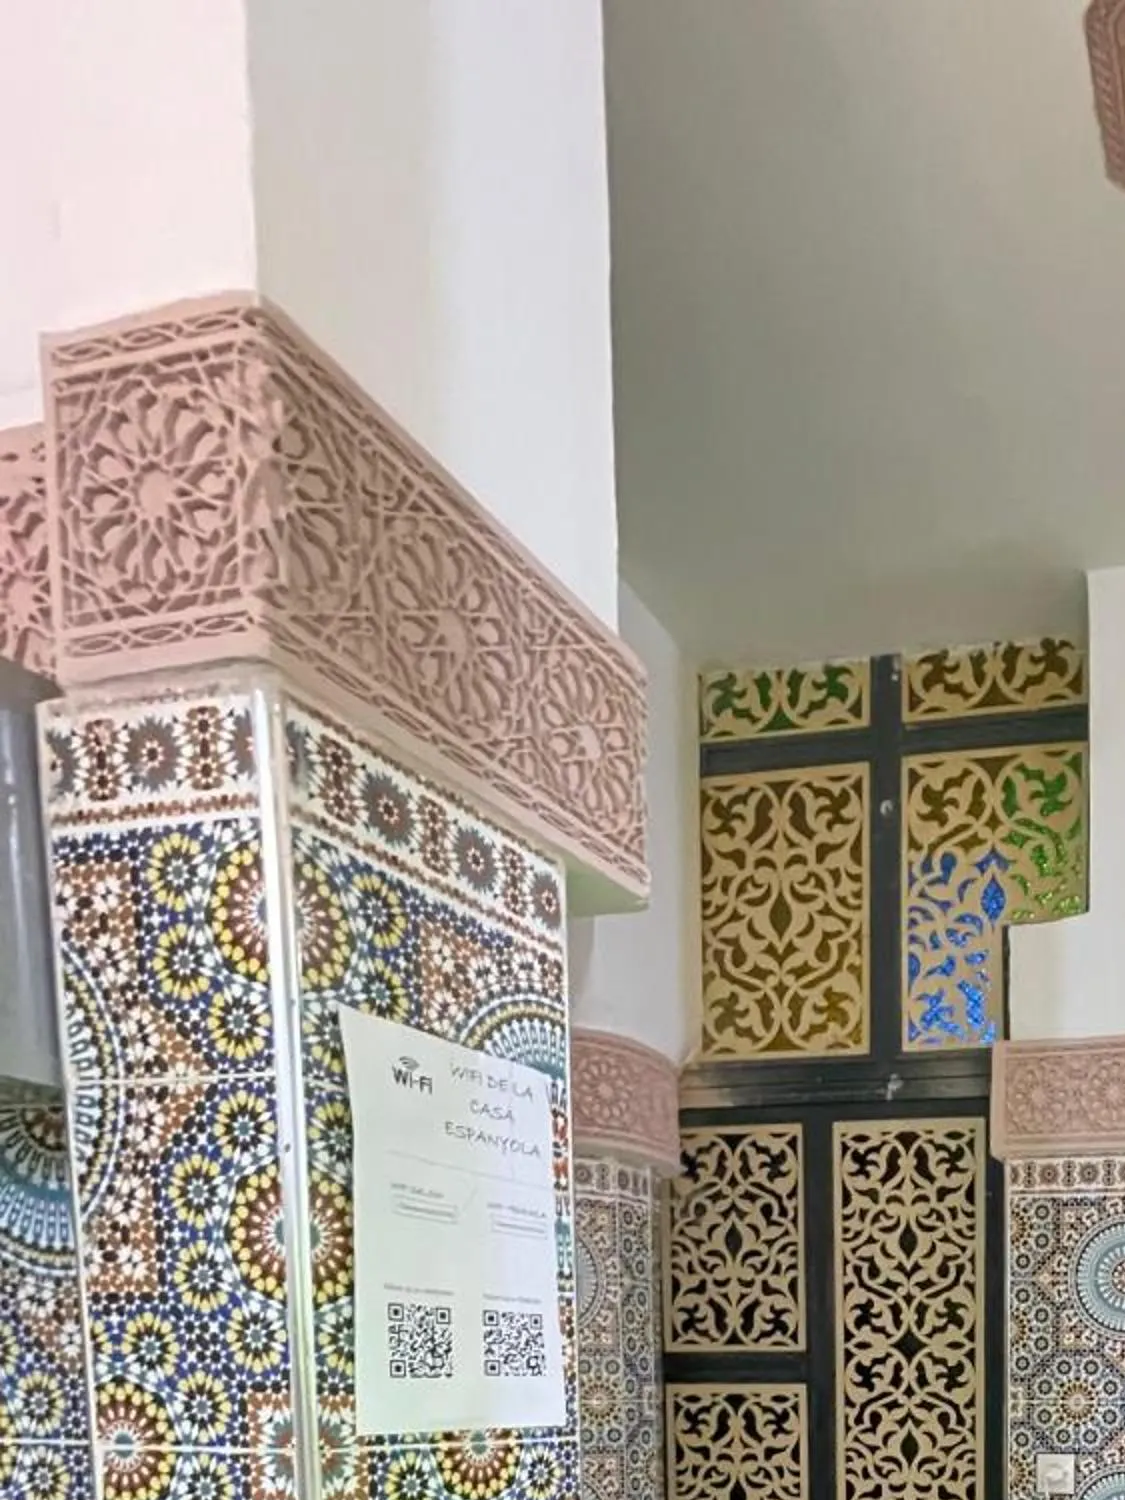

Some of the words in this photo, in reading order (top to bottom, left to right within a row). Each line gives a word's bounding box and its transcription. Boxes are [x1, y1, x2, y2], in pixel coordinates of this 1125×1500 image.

[487, 1076, 508, 1091] DE
[512, 1082, 533, 1101] LA
[470, 1099, 514, 1122] CASA
[445, 1121, 540, 1157] ESPANYOLA
